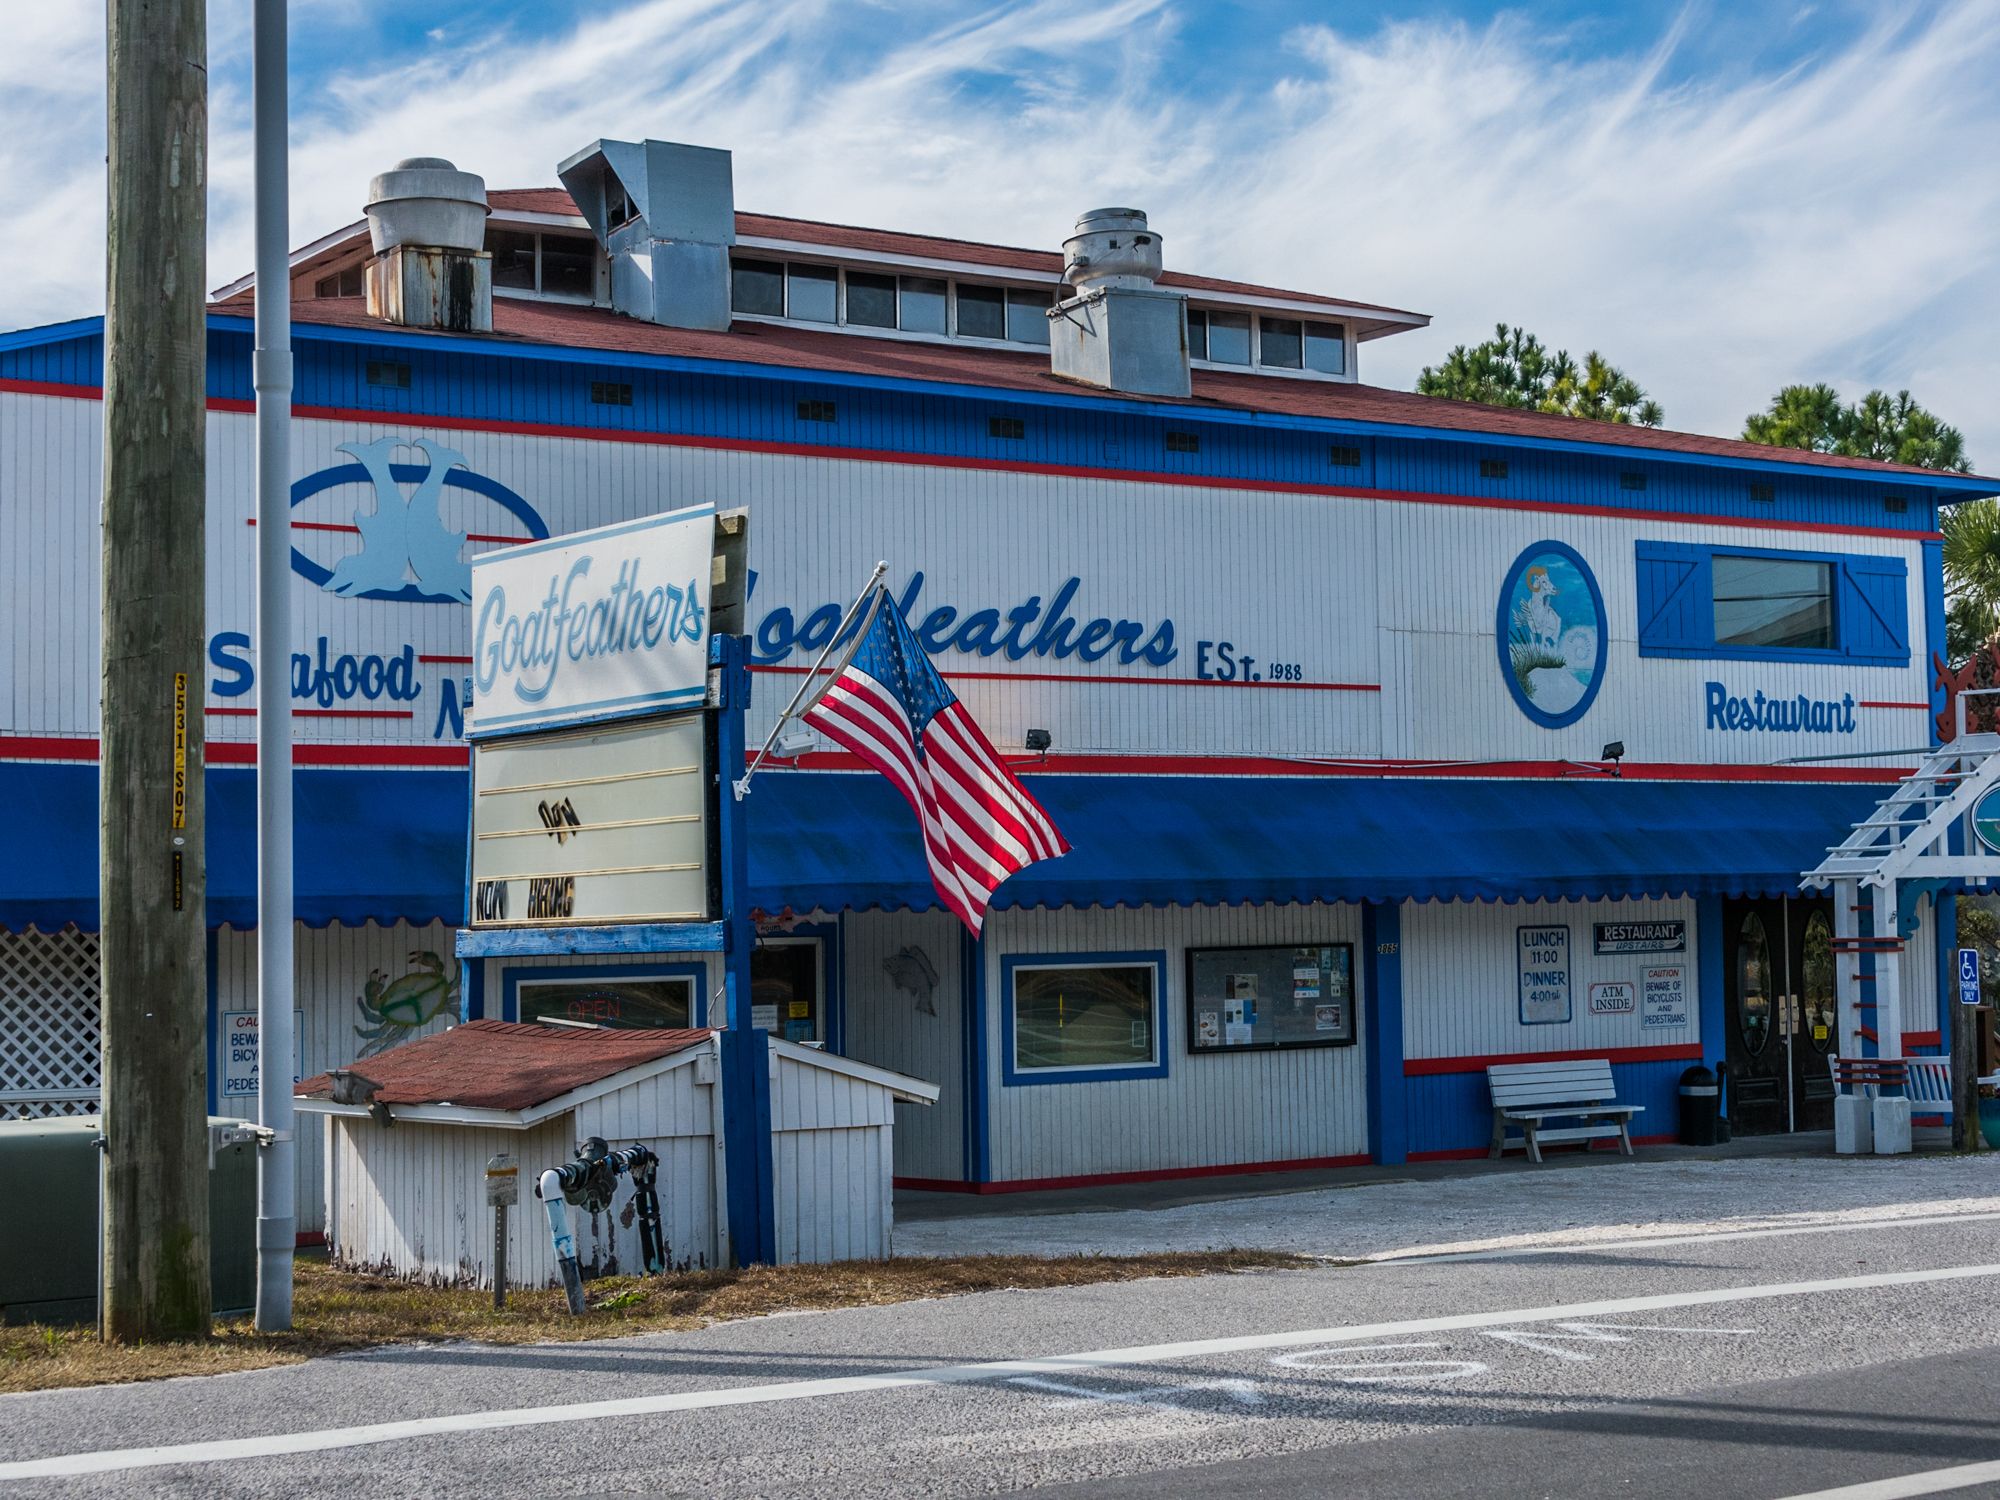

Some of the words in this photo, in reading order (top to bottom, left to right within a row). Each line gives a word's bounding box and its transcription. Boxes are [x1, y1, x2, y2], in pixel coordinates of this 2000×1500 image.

[474, 555, 705, 703] Goatfeathers
[209, 631, 422, 709] Safood
[1269, 662, 1303, 682] 1988
[1704, 681, 1856, 733] Restaurant
[527, 877, 574, 918] HIRING
[1523, 931, 1565, 947] LUNCH
[1604, 924, 1677, 941] RESTAURANT
[1616, 940, 1665, 950] UPSTAIRS
[1531, 950, 1558, 963] 11:00
[1523, 971, 1566, 987] DINNER
[1648, 968, 1680, 978] CAUTION
[1601, 986, 1624, 998] ATM
[1645, 981, 1671, 992] BEWARE
[1673, 980, 1682, 990] OF
[1595, 998, 1631, 1011] INSIDE
[1647, 992, 1682, 1004] BICYCLISTS
[567, 1000, 622, 1021] OPEN
[1657, 1004, 1673, 1012] AND
[1644, 1013, 1686, 1025] PEDESTRIANS
